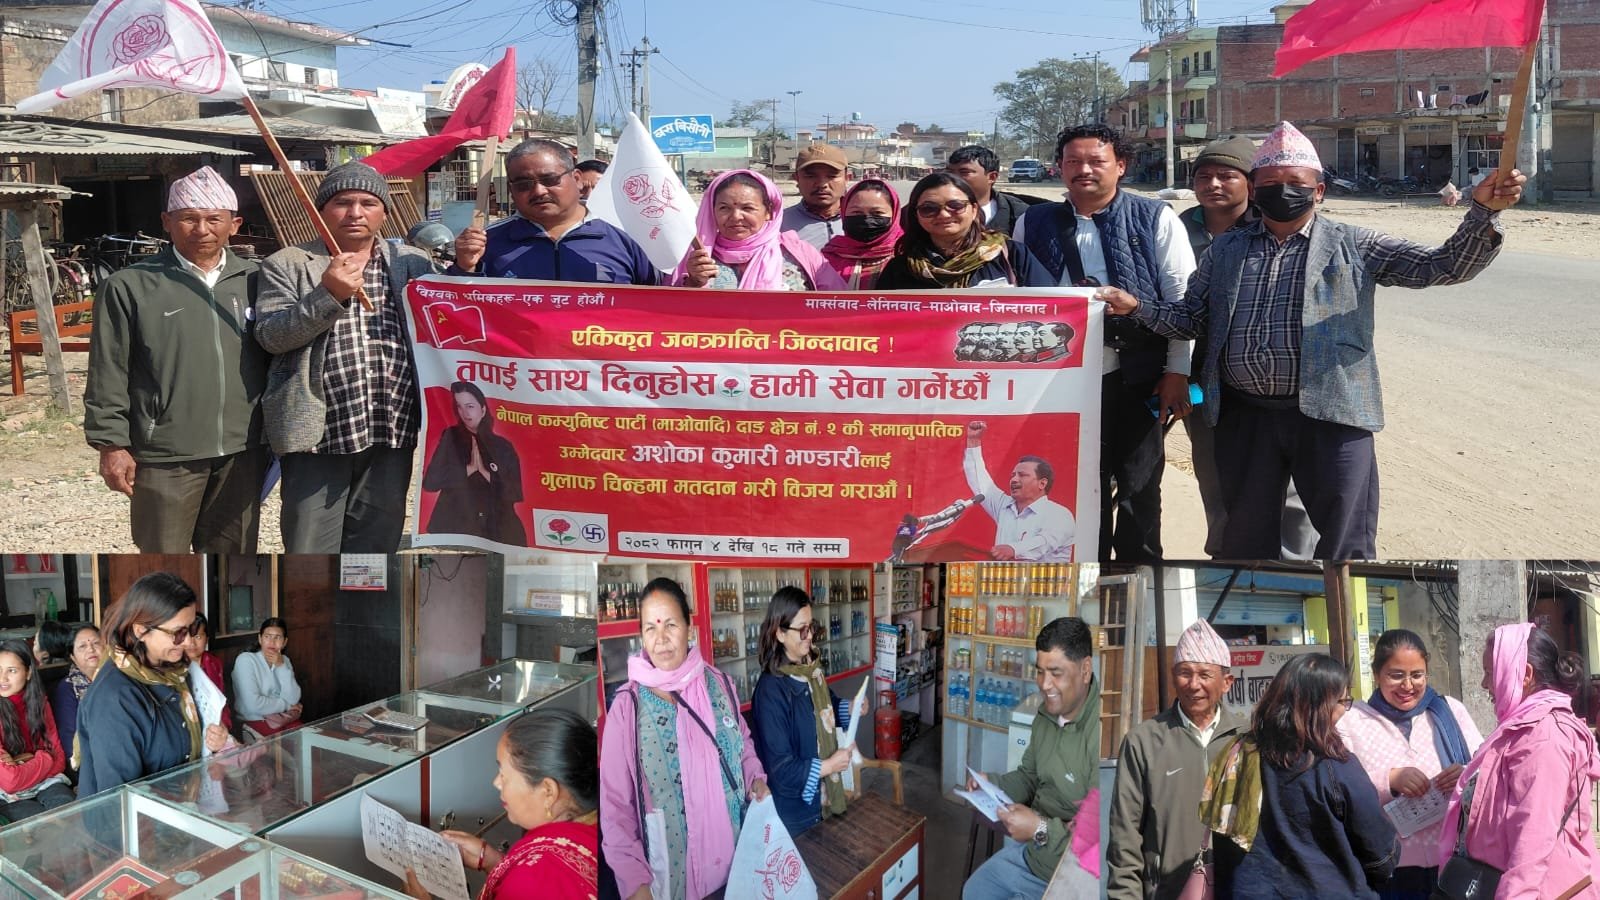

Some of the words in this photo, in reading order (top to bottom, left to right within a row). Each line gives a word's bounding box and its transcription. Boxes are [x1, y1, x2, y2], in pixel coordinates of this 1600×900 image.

[550, 294, 571, 308] जुट
[571, 325, 652, 352] एकिकृत
[456, 360, 517, 391] तपाई
[528, 368, 589, 392] साथ
[601, 363, 718, 399] दिनुहोस
[750, 368, 819, 398] हामी
[829, 369, 888, 400] सेवा
[496, 406, 533, 425] नेपाल
[538, 412, 609, 431] कम्युनिष्ट
[615, 414, 647, 430] पार्टी
[769, 418, 799, 435] क्षेत्र
[827, 423, 837, 435] २
[842, 420, 864, 436] की
[869, 420, 964, 440] समानुपातिक
[559, 444, 626, 461] उम्मेदवार
[632, 441, 704, 464] अशोका
[711, 444, 778, 469] कुमारी
[541, 472, 597, 491] गुलाफ
[603, 473, 667, 494] चिन्हमा
[674, 479, 738, 497] मतदान
[743, 478, 777, 498] गरी
[783, 478, 833, 498] विजय
[625, 537, 659, 550] २०८२
[667, 539, 703, 554] फागुन
[711, 540, 720, 552] ४
[728, 538, 754, 552] देखि
[761, 542, 778, 554] १८
[786, 540, 806, 553] गते
[813, 543, 842, 554] सम्म
